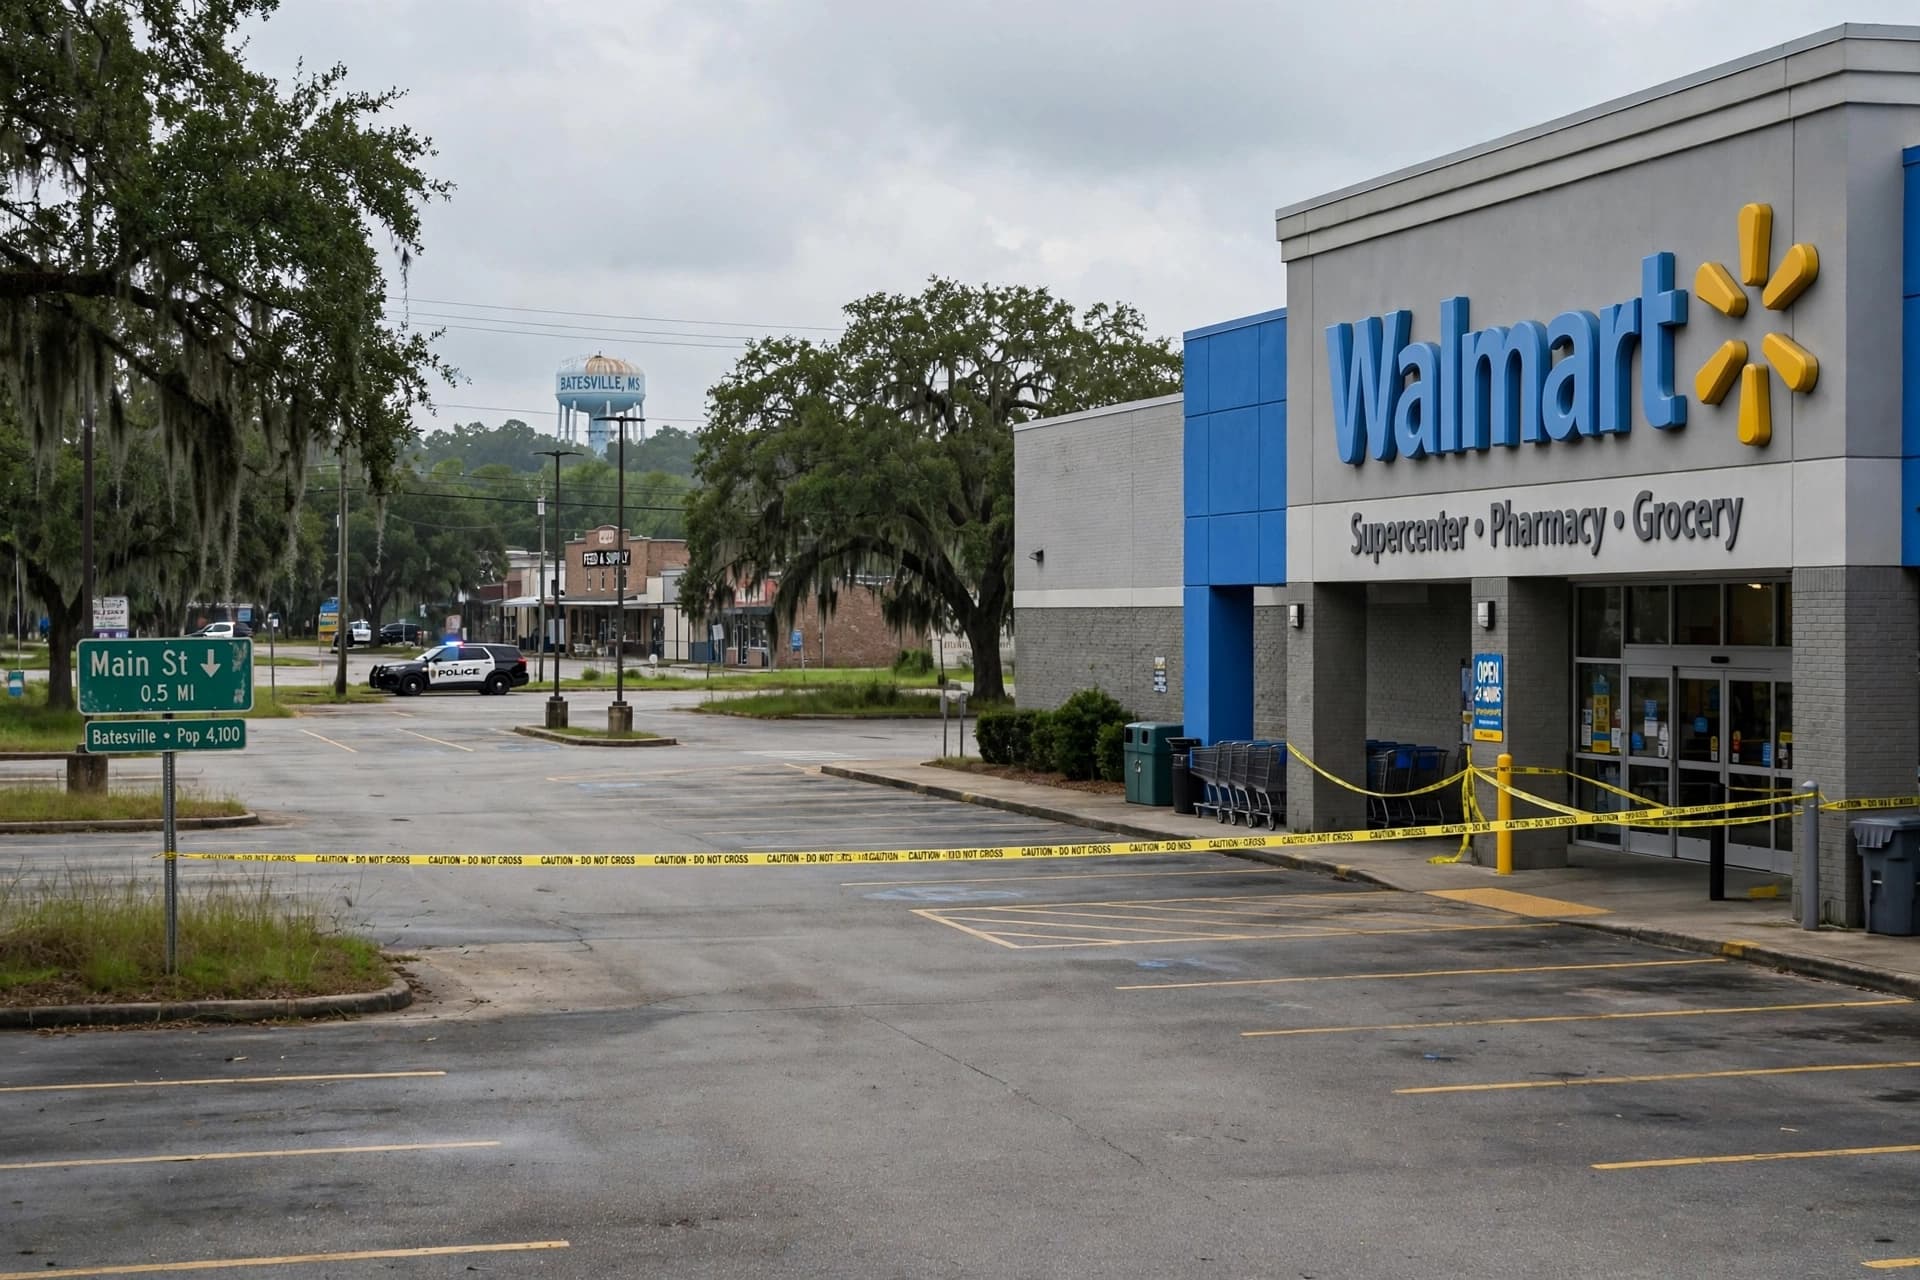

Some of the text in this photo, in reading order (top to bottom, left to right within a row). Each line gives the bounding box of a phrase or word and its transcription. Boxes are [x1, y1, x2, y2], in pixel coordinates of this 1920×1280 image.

[1326, 251, 1688, 465] Walmart
[561, 376, 640, 392] BATESVILLE, MS
[1351, 490, 1744, 563] Supercenter Pharmacy Grocery
[91, 649, 188, 677] Main St
[438, 668, 481, 678] POLICE
[1477, 661, 1499, 683] OPEN
[141, 684, 194, 702] 0.5 MI
[93, 726, 240, 747] Batesville Pop 4,100
[1021, 845, 1111, 856] CAUTION DO NOT CROSS
[1129, 843, 1159, 852] CAUTION
[767, 854, 799, 863] CAUTION
[807, 854, 816, 862] DO
[819, 853, 833, 862] NOT
[963, 850, 977, 859] NOT
[980, 849, 1003, 858] CROSS
[316, 855, 348, 863] CAUTION
[386, 856, 410, 864] CROSS
[429, 856, 522, 864] CAUTION DO NOT CROSS
[541, 856, 635, 864] CAUTION DO NOT CROSS
[655, 855, 748, 864] CAUTION DO NOT CROSS
